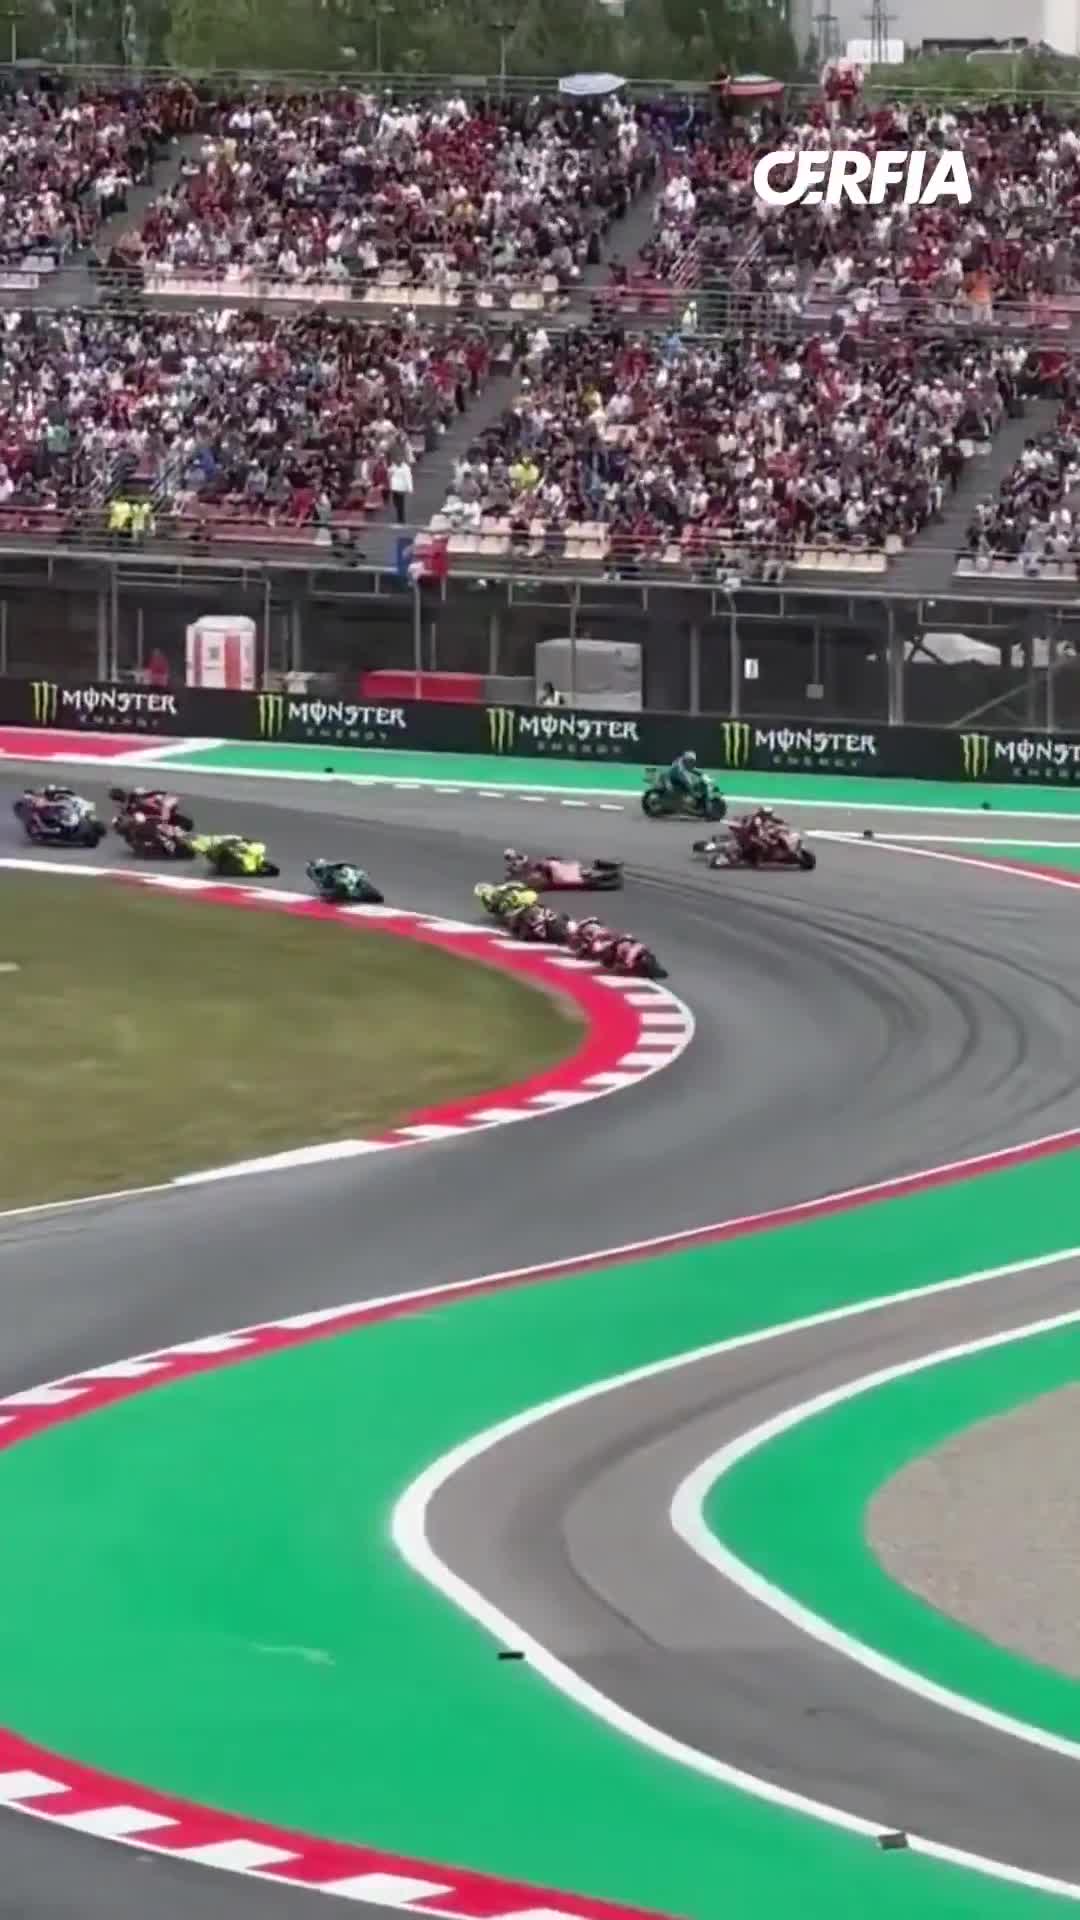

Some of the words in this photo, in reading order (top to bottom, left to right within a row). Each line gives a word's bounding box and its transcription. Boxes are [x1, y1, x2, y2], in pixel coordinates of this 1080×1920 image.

[62, 685, 176, 715] MONSTER
[289, 699, 406, 728] MONSTER
[519, 713, 639, 741] MONSTER
[755, 728, 876, 755] MONSTER
